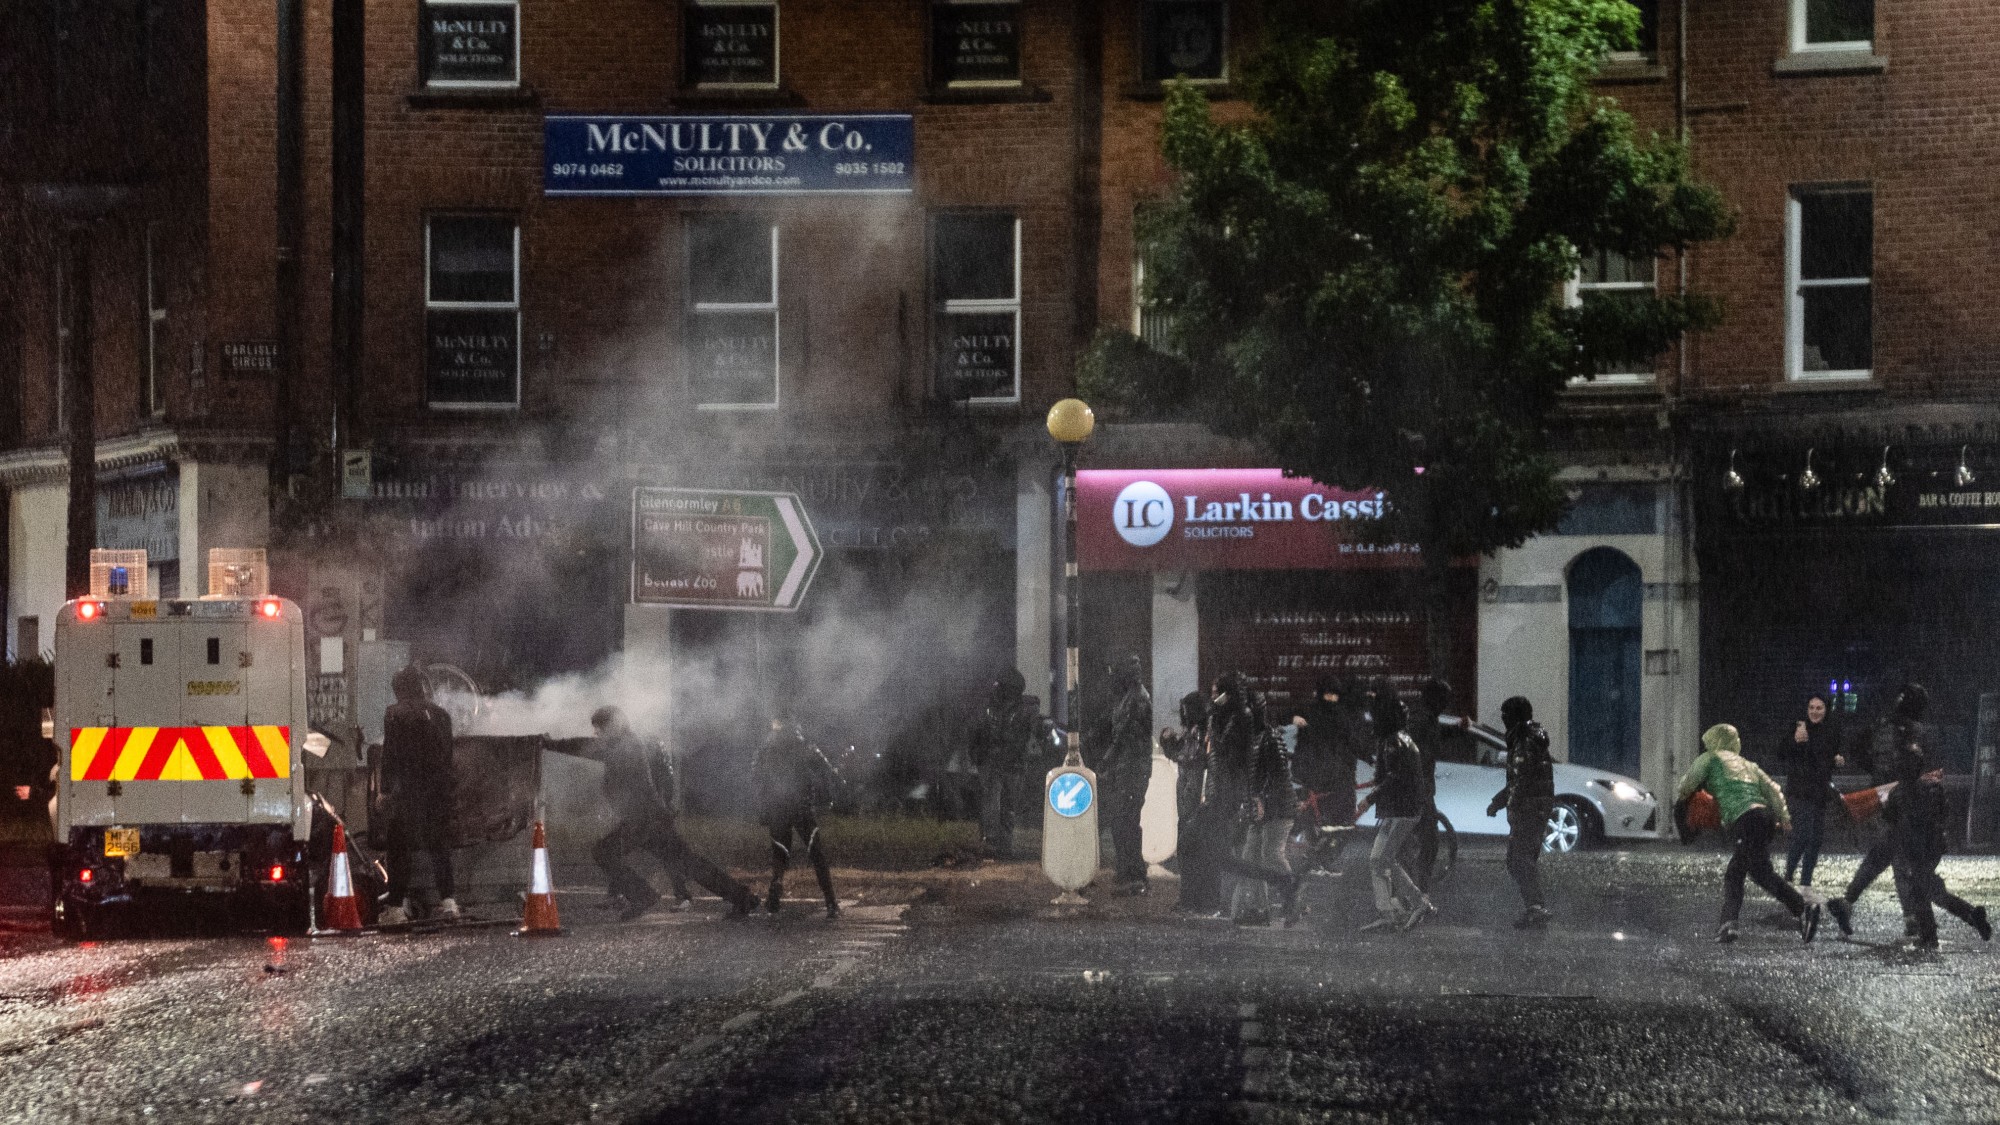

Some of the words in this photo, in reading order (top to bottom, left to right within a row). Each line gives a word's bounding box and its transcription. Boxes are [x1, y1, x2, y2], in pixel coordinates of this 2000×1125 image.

[452, 36, 464, 49] &
[586, 123, 774, 151] McNULTY
[782, 122, 809, 151] &
[819, 122, 873, 151] Co.
[553, 162, 587, 175] 9074
[590, 163, 624, 175] 0462
[673, 156, 786, 172] SOLICITORS
[836, 162, 870, 175] 9035
[659, 175, 800, 187] www.mcnultyandco.com
[224, 344, 278, 356] CARLISLE
[232, 357, 271, 369] CIRCUS
[1184, 493, 1293, 521] Larkin
[1301, 493, 1385, 521] Cassi
[645, 519, 669, 531] Cave
[674, 521, 692, 532] Hill
[696, 521, 738, 536] Country
[742, 522, 765, 534] Park
[1184, 527, 1254, 539] SOLICITORS
